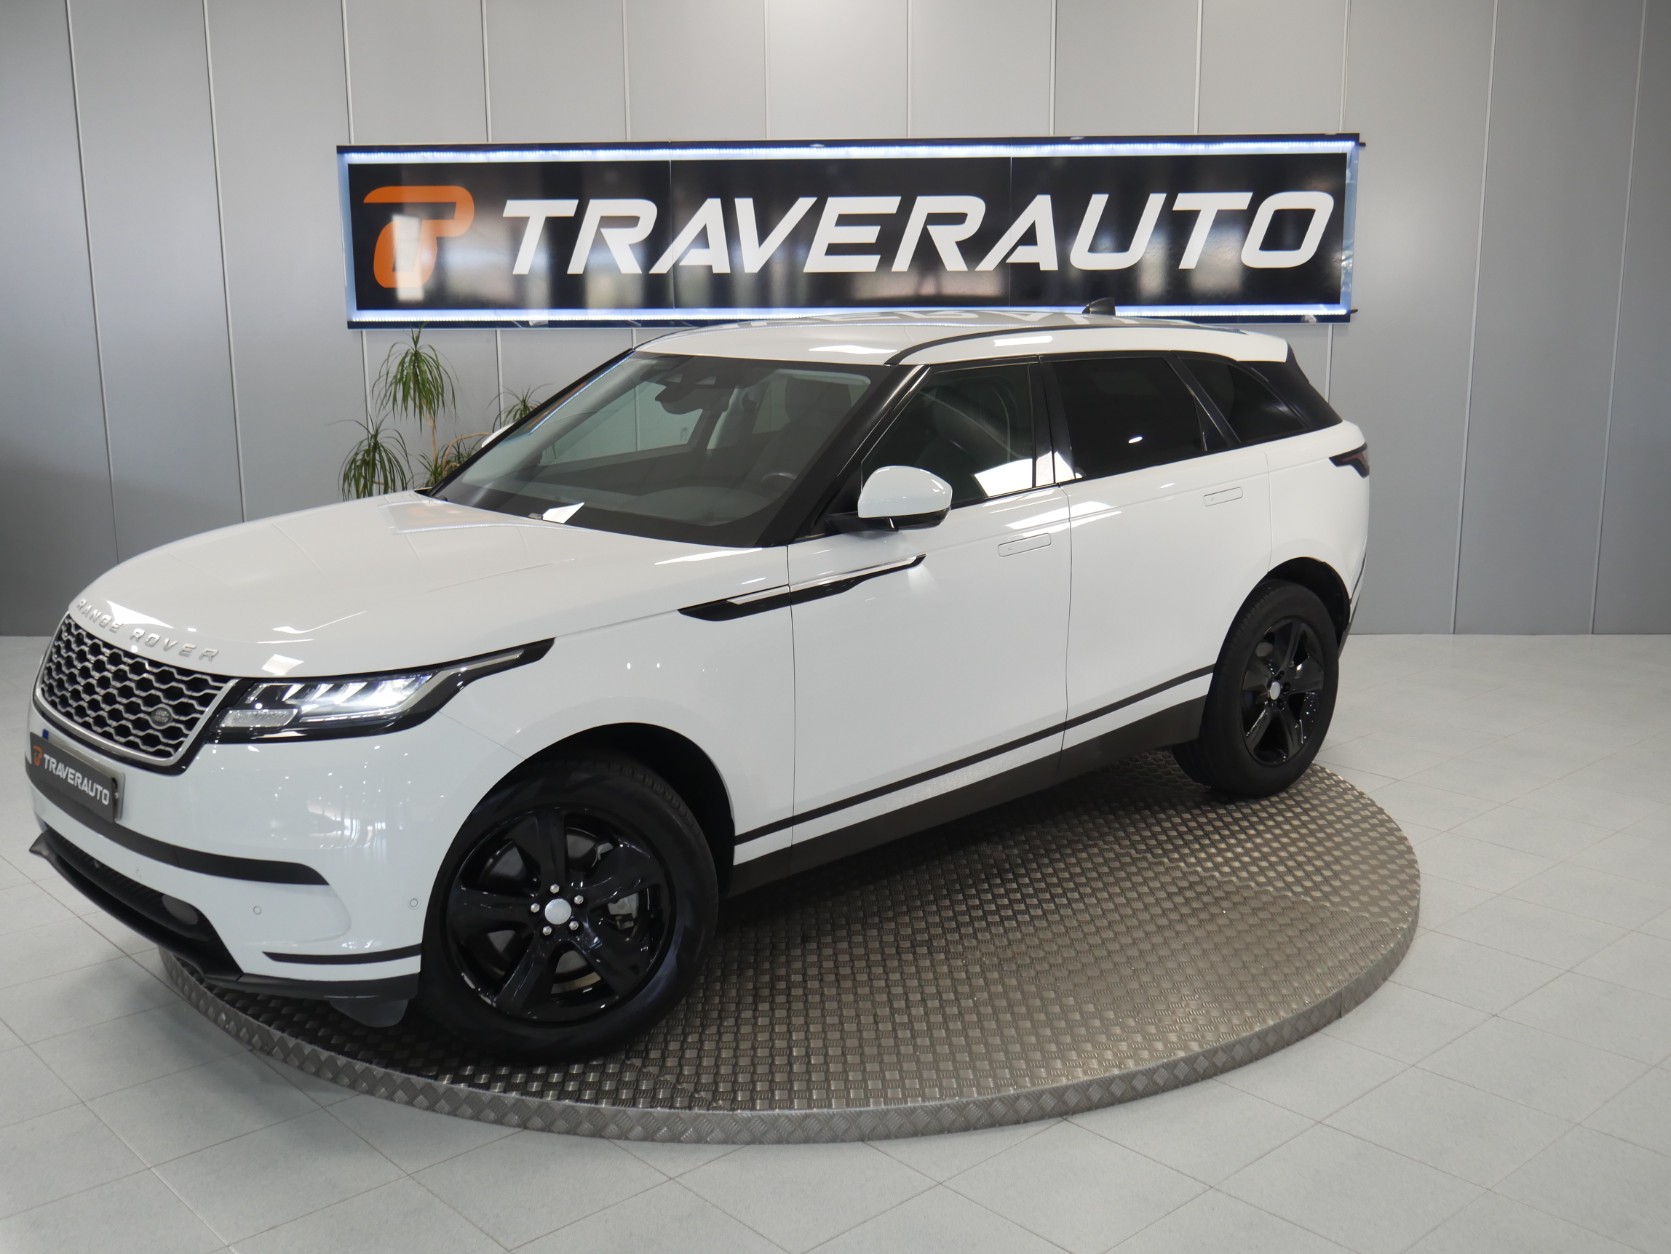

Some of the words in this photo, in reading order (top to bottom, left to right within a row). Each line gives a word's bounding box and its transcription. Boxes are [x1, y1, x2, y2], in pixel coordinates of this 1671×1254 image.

[503, 191, 1335, 275] TRAVERAUTO
[77, 598, 123, 634] RANGE
[130, 627, 220, 662] ROVER
[43, 753, 110, 806] TRAVERAUTO
